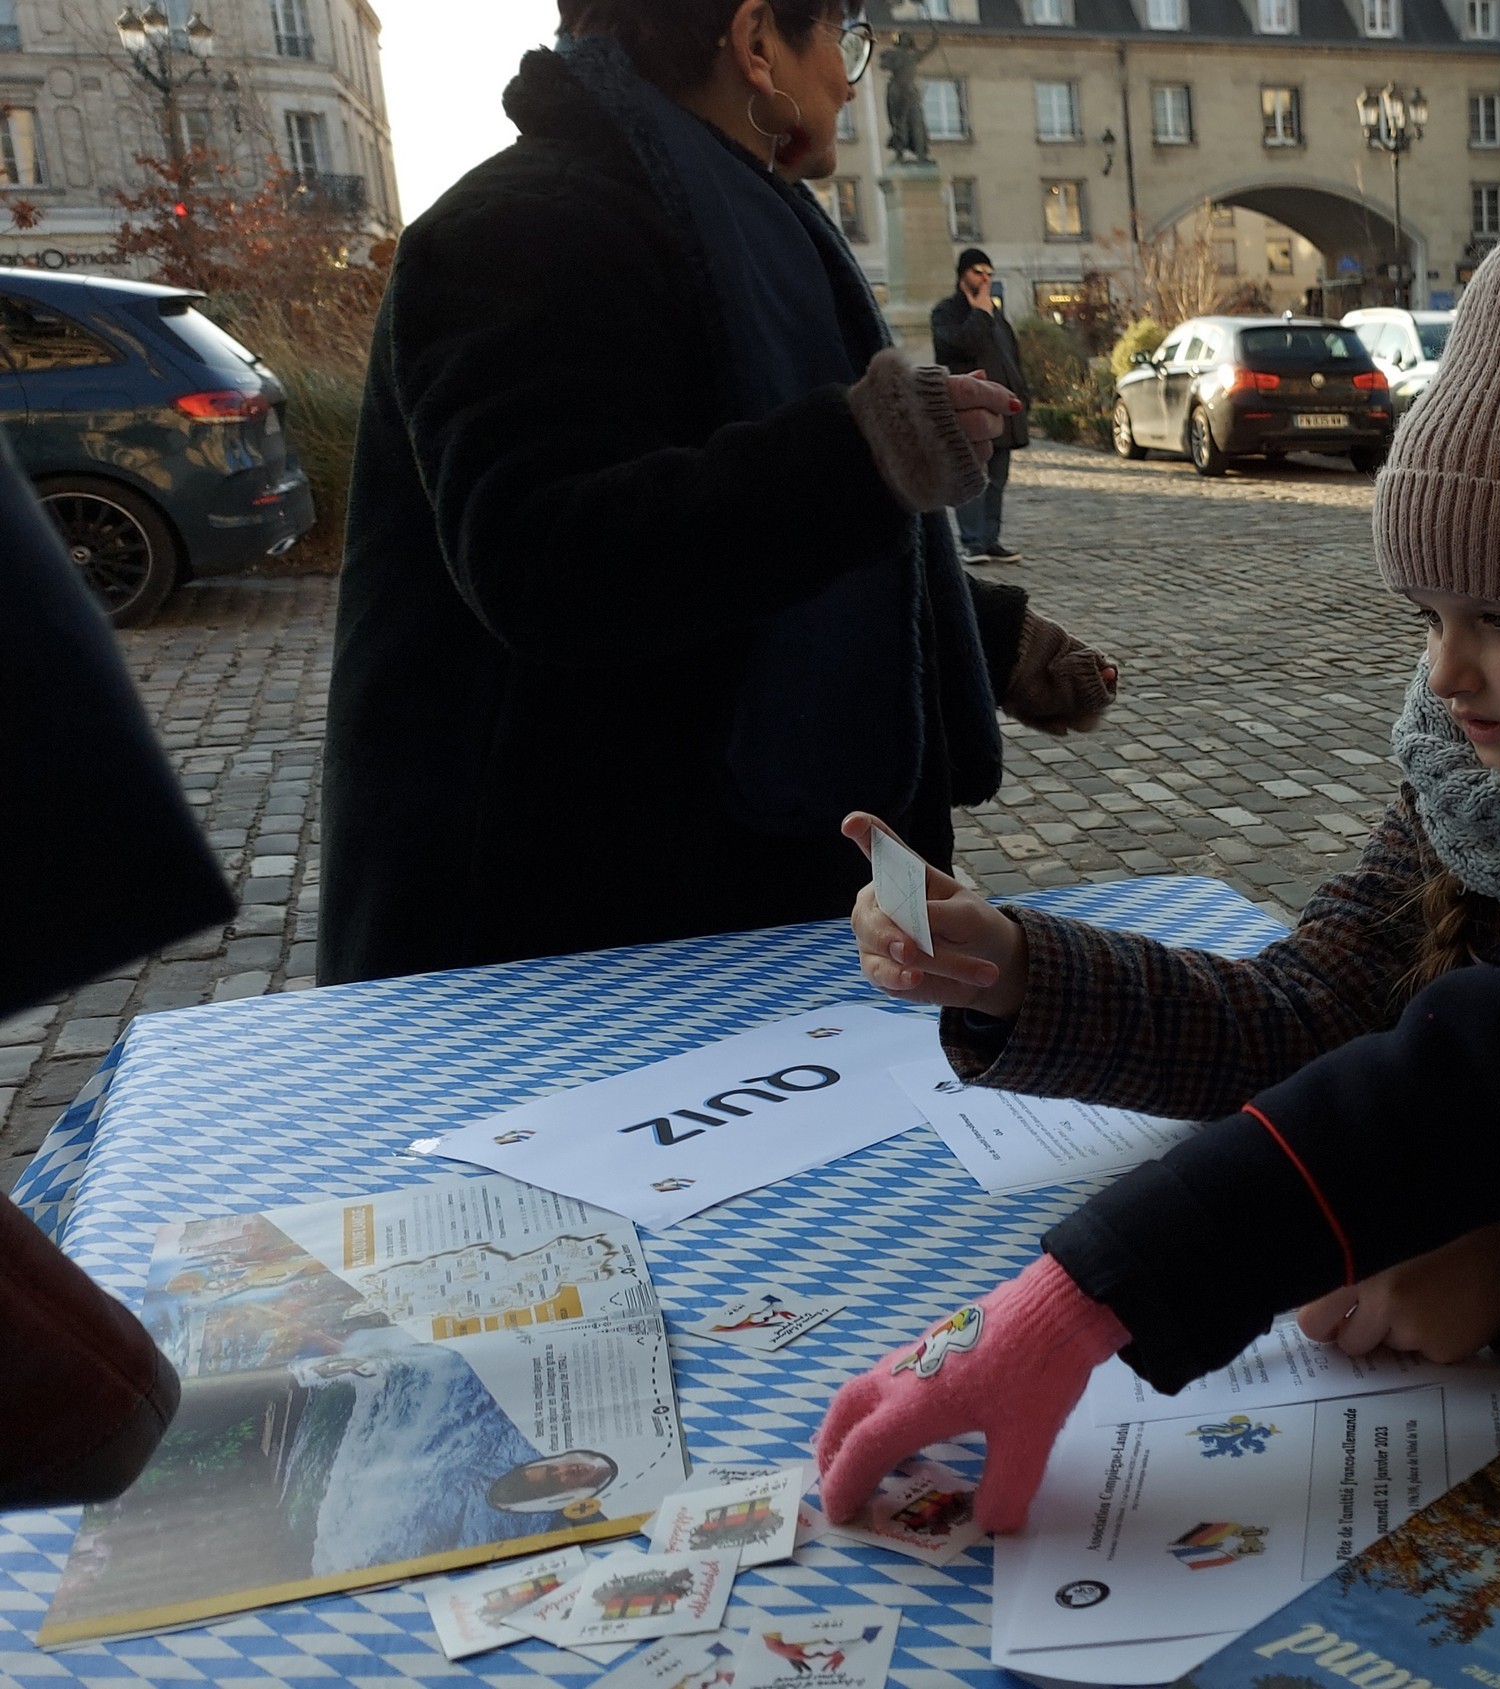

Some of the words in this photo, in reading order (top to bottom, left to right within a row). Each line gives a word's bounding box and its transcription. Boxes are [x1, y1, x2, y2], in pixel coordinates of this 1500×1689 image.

[616, 1064, 841, 1146] QUIZ
[1340, 1408, 1358, 1485] franco-allemande
[1375, 1426, 1389, 1448] 2023
[1374, 1450, 1393, 1481] janvier
[1339, 1488, 1354, 1524] l'amitié
[1374, 1484, 1389, 1498] 21
[1086, 1502, 1111, 1552] Association
[1338, 1524, 1353, 1537] de
[1374, 1499, 1389, 1534] samedi
